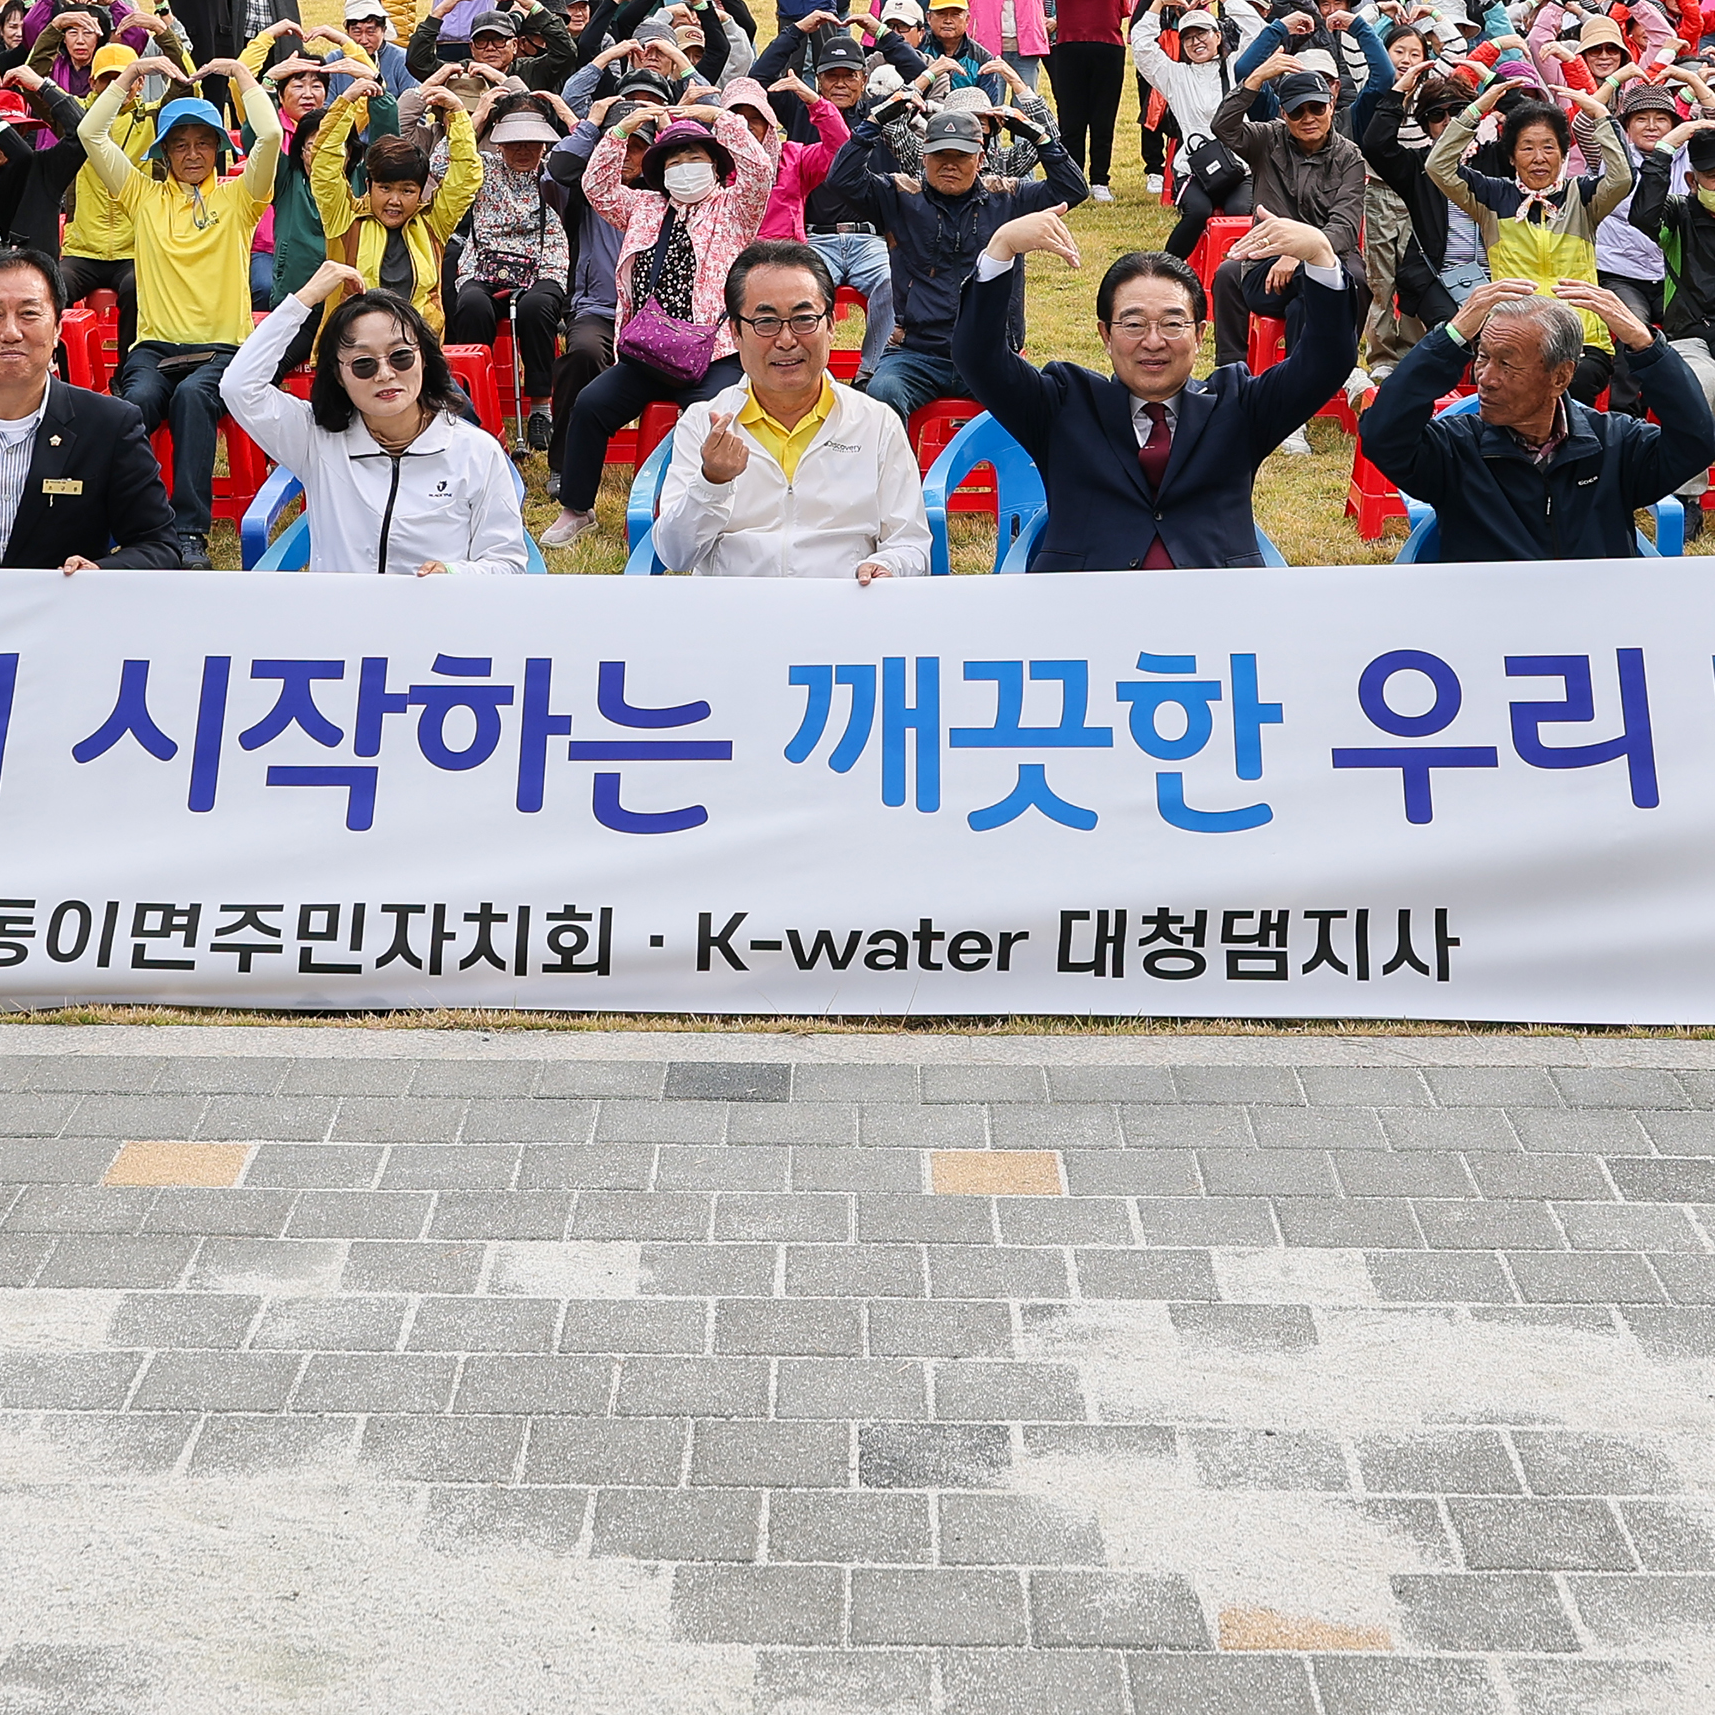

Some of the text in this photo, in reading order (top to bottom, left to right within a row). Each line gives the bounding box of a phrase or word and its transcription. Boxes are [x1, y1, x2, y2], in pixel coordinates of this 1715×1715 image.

[71, 652, 733, 835] 시작하는
[783, 650, 1284, 833] 깨끗한
[1331, 647, 1660, 825] 우리
[696, 911, 1029, 973] K-water
[1056, 906, 1461, 983] 대청댐지사
